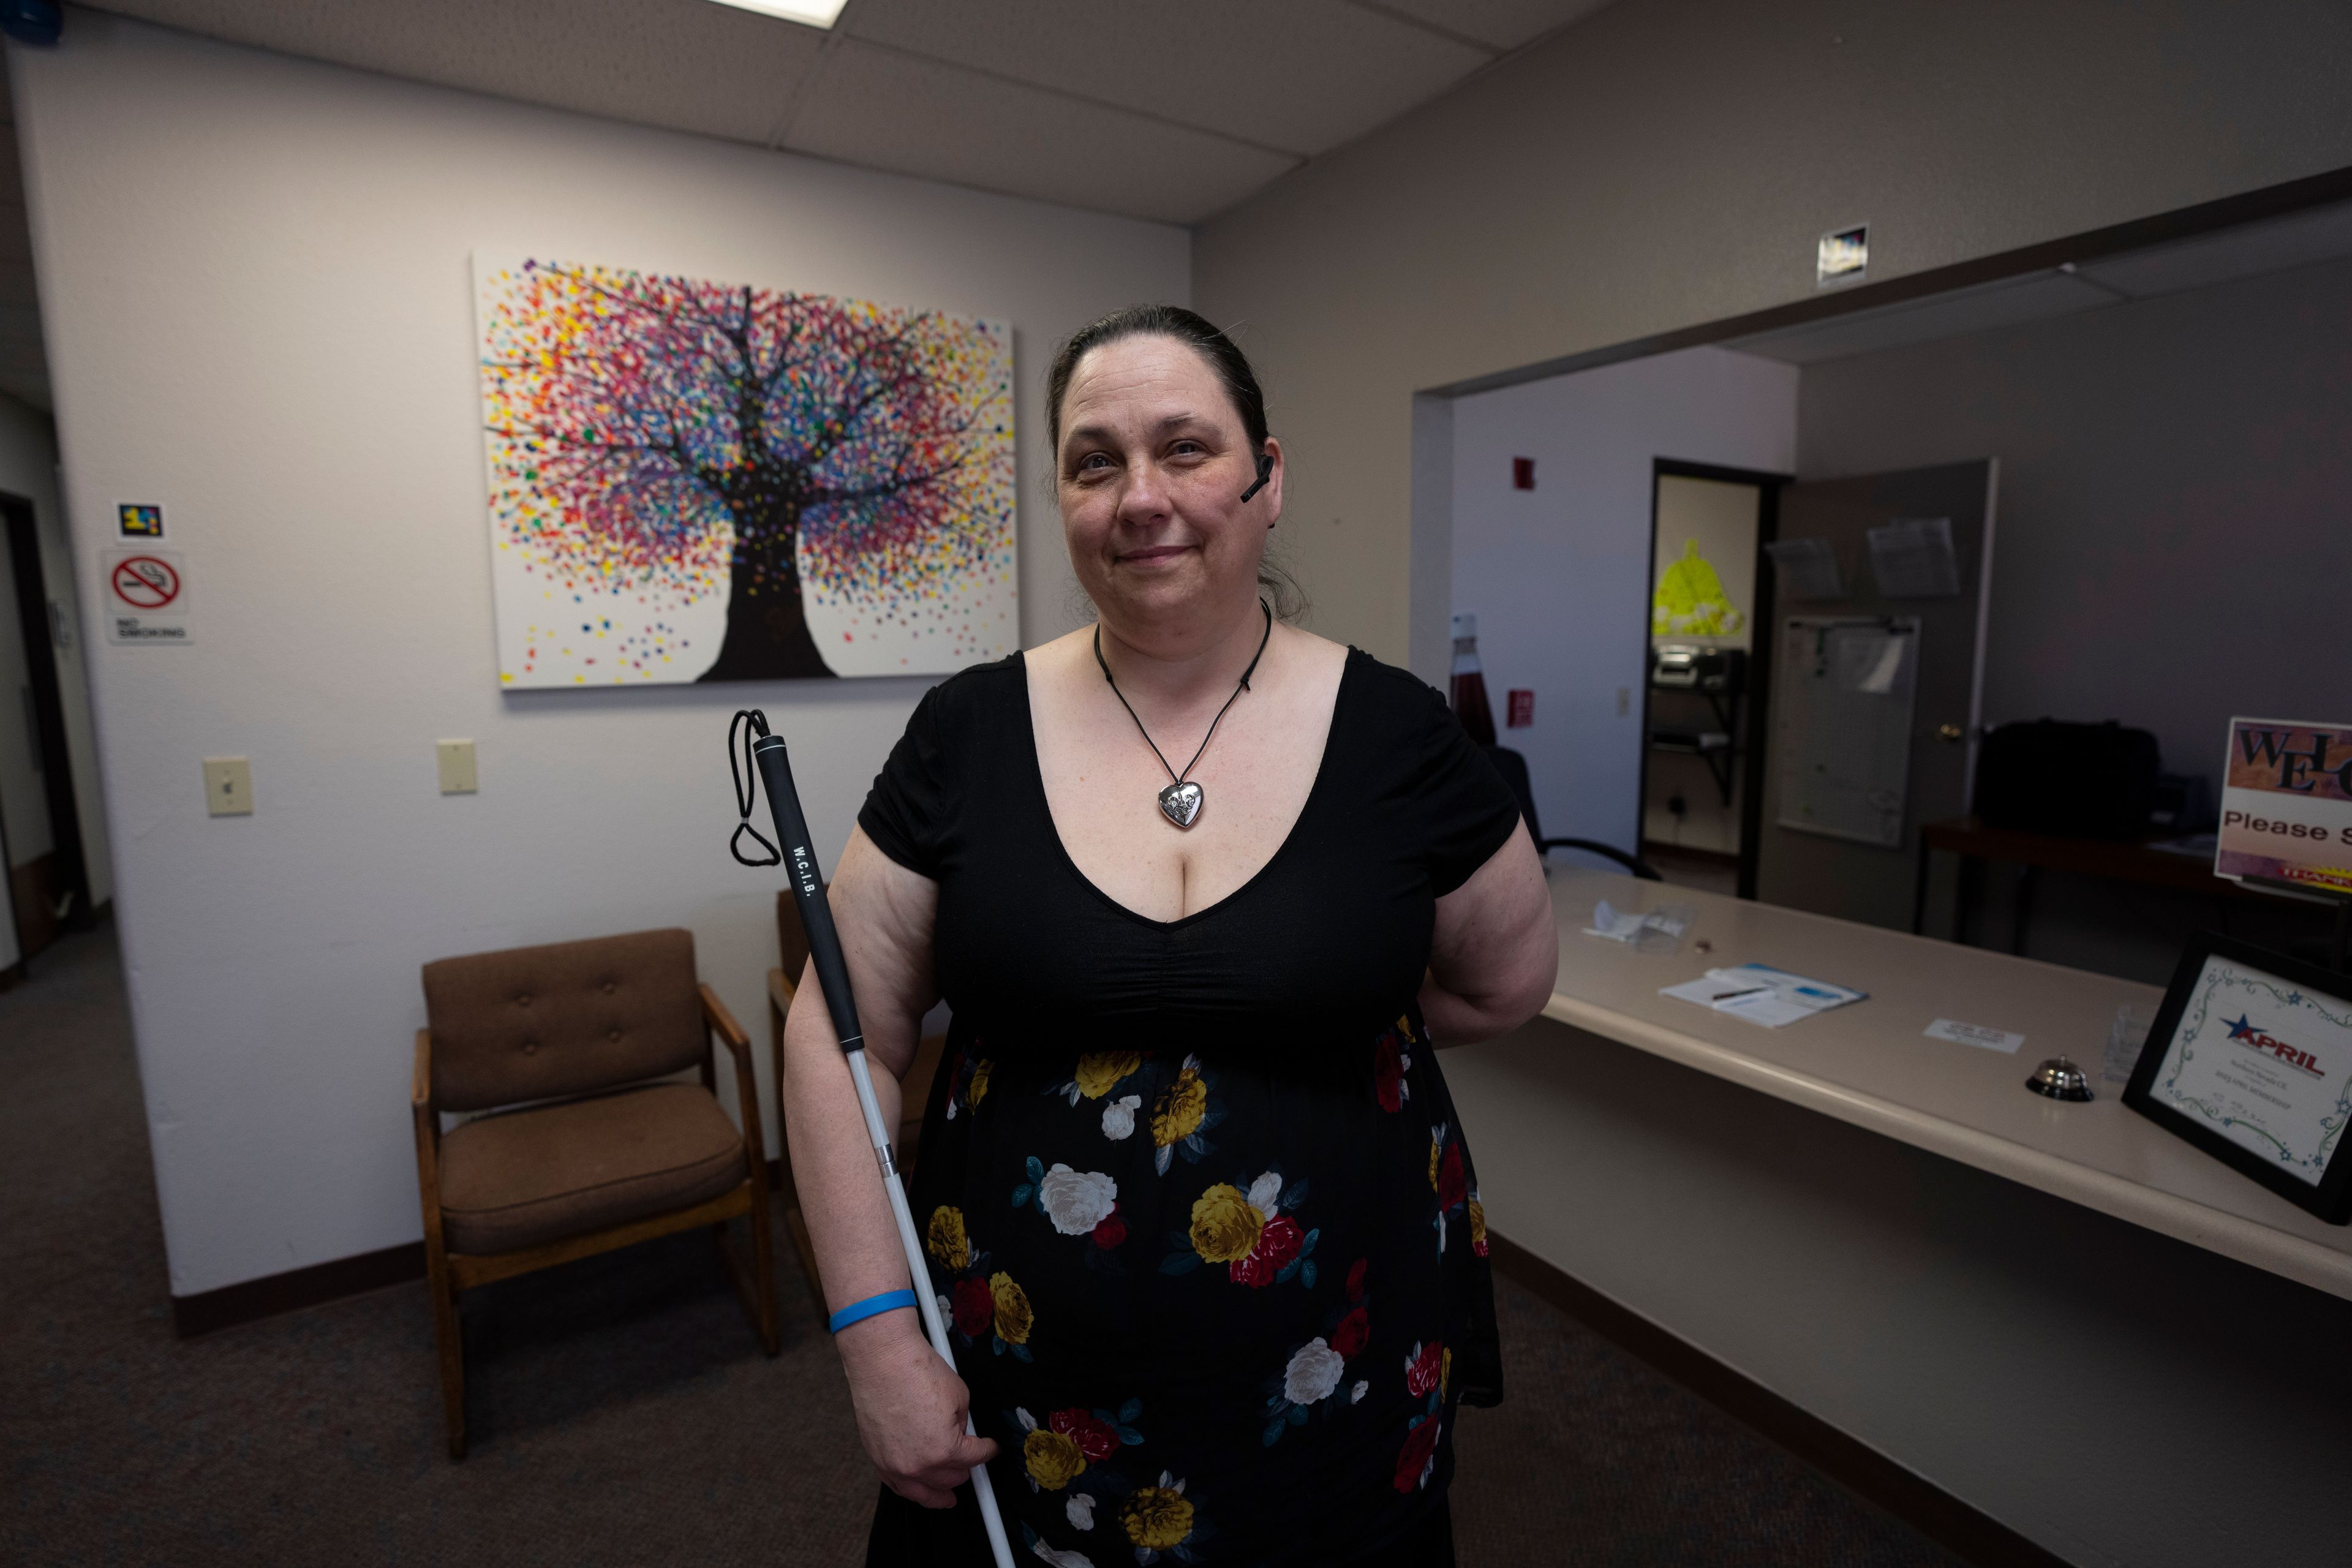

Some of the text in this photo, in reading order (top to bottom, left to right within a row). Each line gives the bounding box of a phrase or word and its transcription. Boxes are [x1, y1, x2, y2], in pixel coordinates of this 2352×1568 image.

[116, 617, 140, 627] NO
[118, 627, 186, 638] SMOKING
[2224, 810, 2329, 841] Please
[793, 846, 815, 897] W.C.I.B.
[2234, 1028, 2325, 1076] APRIL
